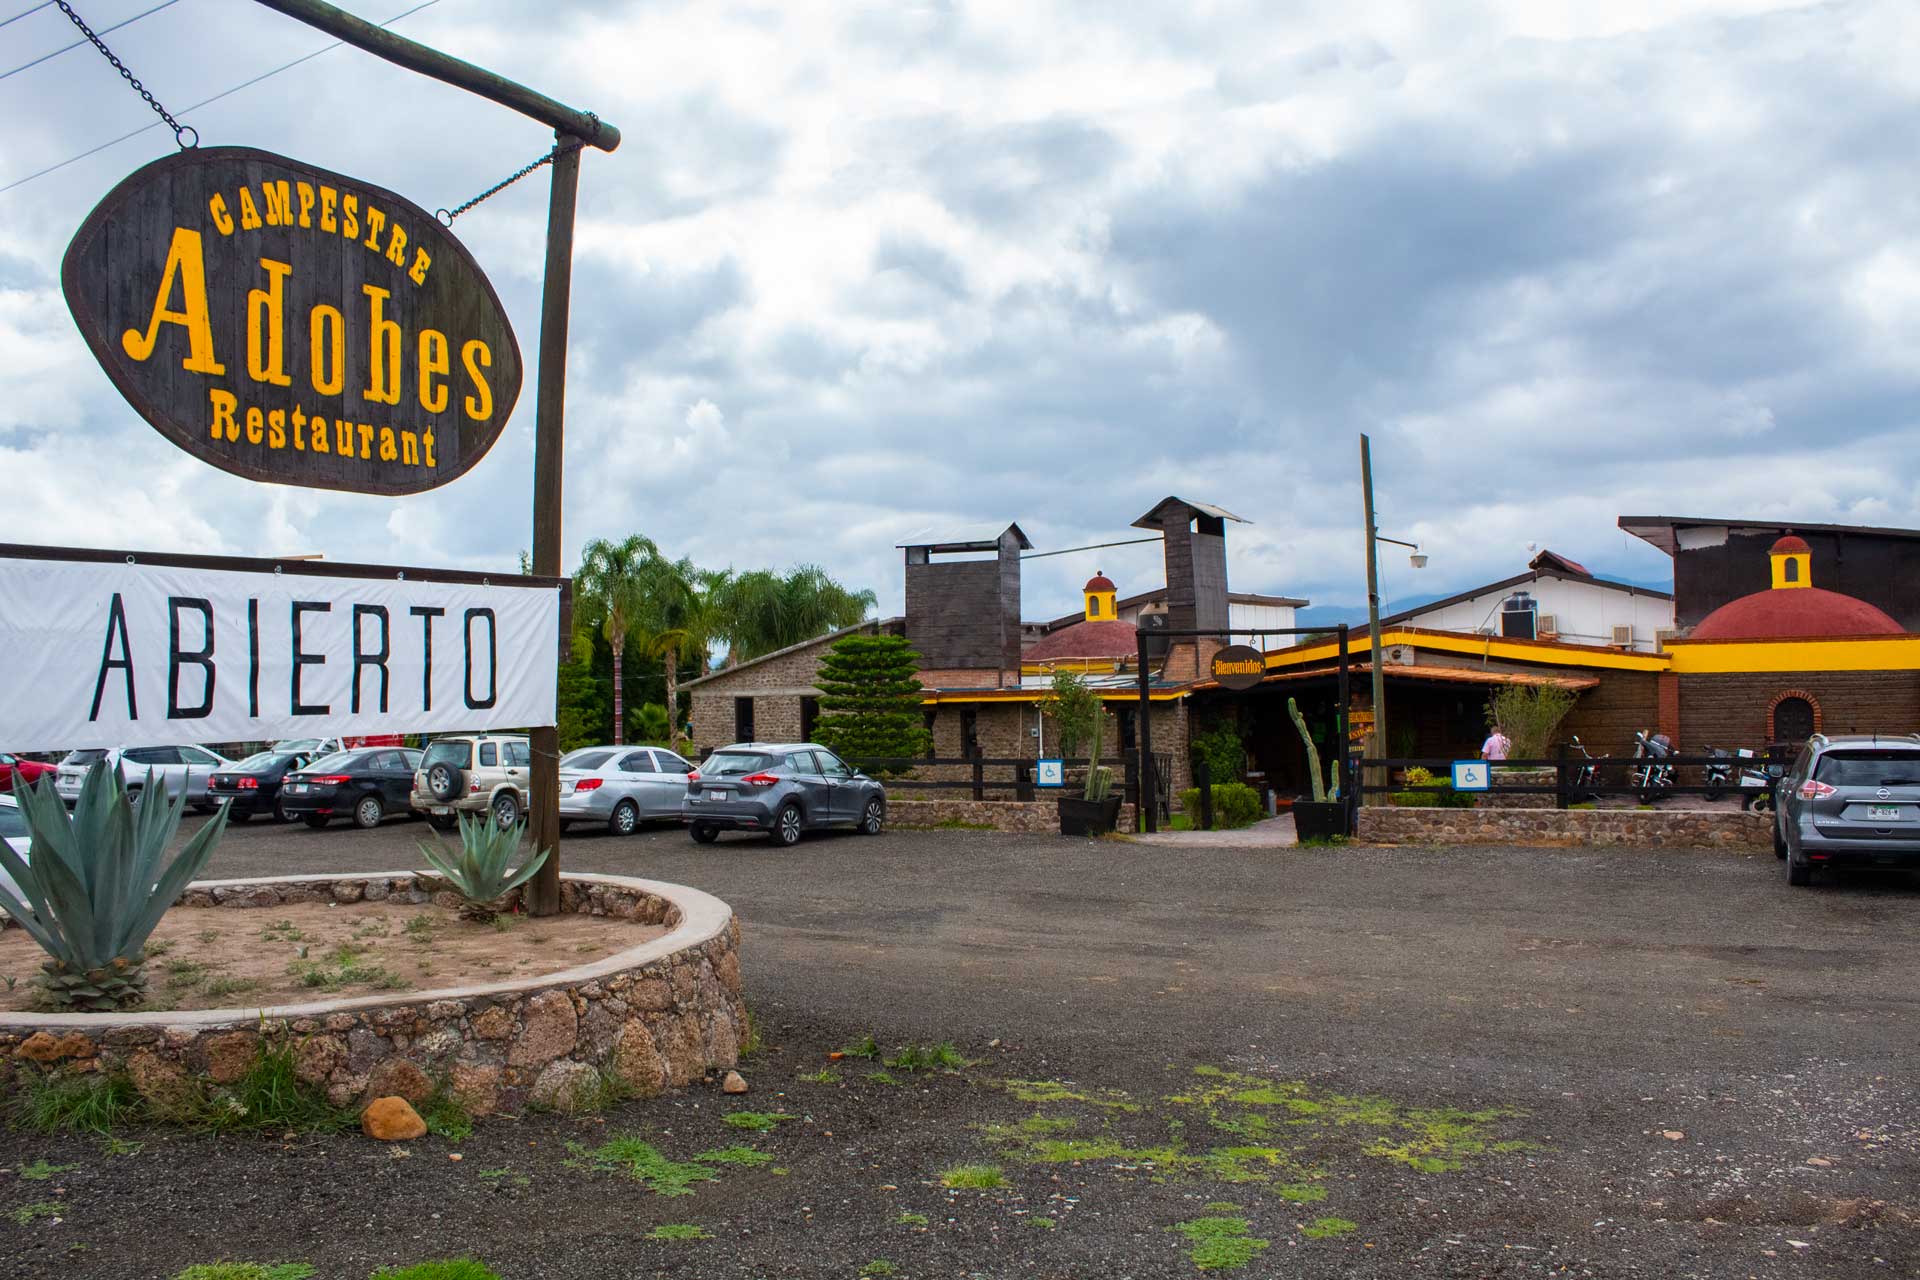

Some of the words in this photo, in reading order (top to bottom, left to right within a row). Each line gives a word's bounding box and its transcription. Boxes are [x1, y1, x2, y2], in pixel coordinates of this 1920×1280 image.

[209, 180, 431, 286] CAMPESTRE
[122, 227, 493, 421] Adobes
[209, 388, 437, 468] Restaurant
[89, 592, 497, 721] ABIERTO
[1215, 659, 1261, 675] Bienvenidos
